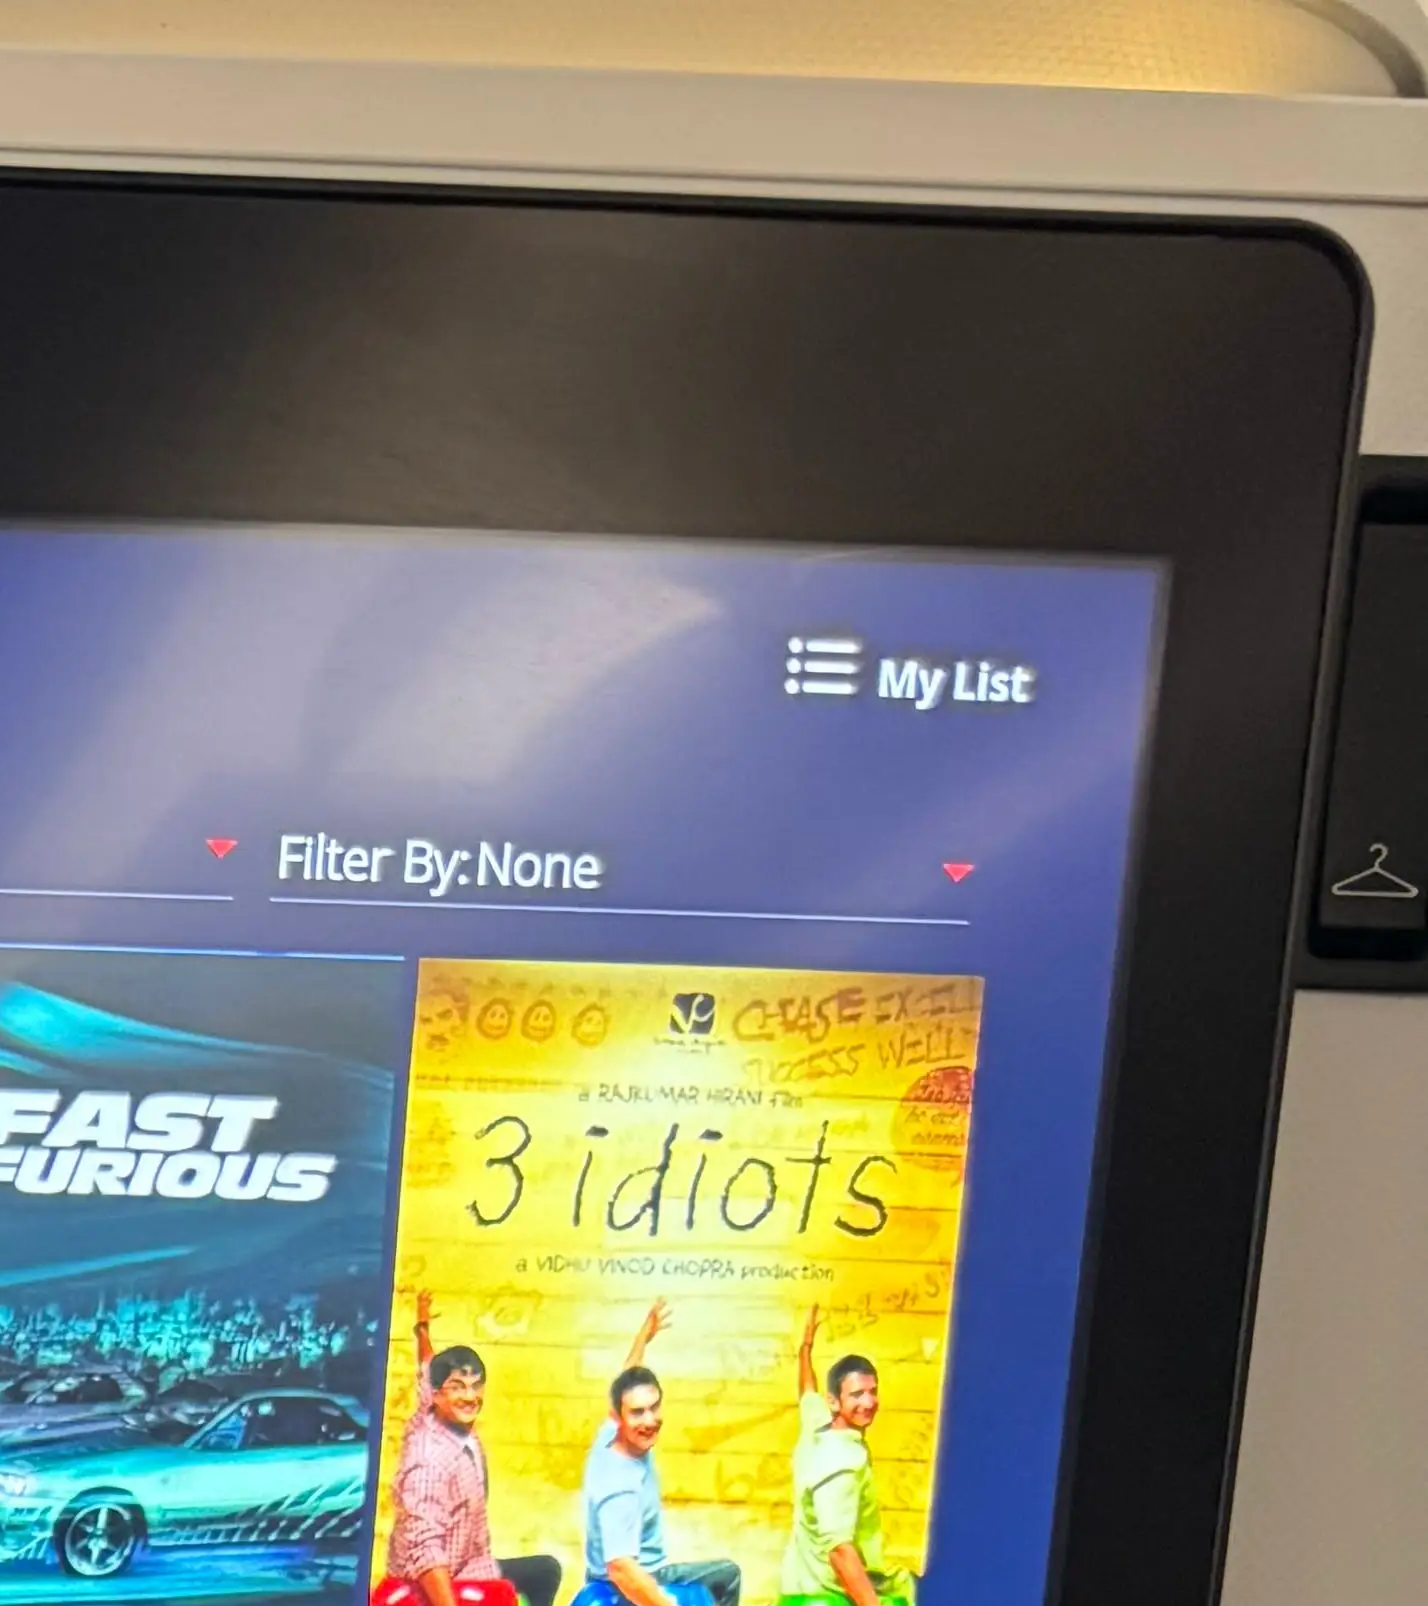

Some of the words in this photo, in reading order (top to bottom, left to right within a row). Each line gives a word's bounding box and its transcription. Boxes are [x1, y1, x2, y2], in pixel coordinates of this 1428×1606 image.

[879, 659, 946, 709] My
[954, 662, 1033, 702] List
[279, 832, 395, 882] Filter
[465, 1114, 532, 1227] 3
[571, 1118, 897, 1237] idiots
